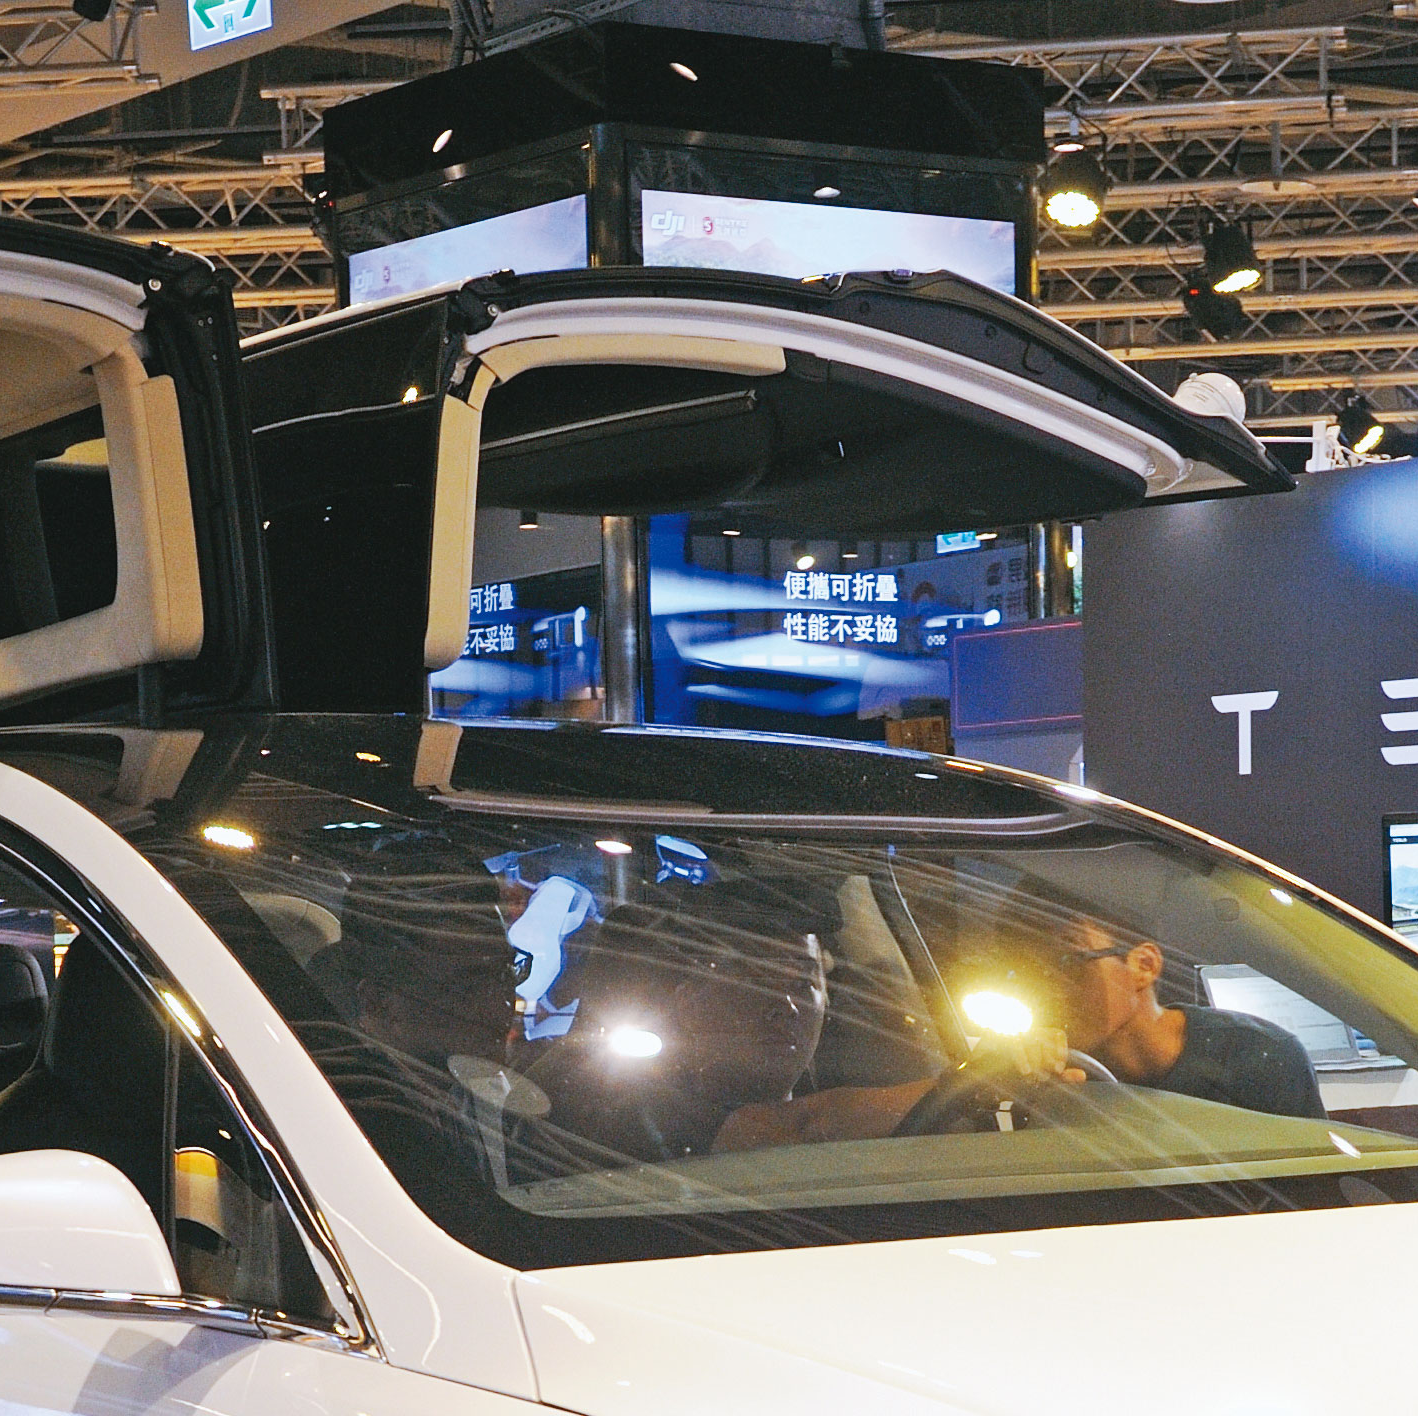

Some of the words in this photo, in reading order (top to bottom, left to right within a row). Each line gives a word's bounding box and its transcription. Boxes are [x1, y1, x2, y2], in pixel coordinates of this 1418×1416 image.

[783, 571, 898, 601] 便攜可折疊
[783, 612, 898, 643] 性能不妥協
